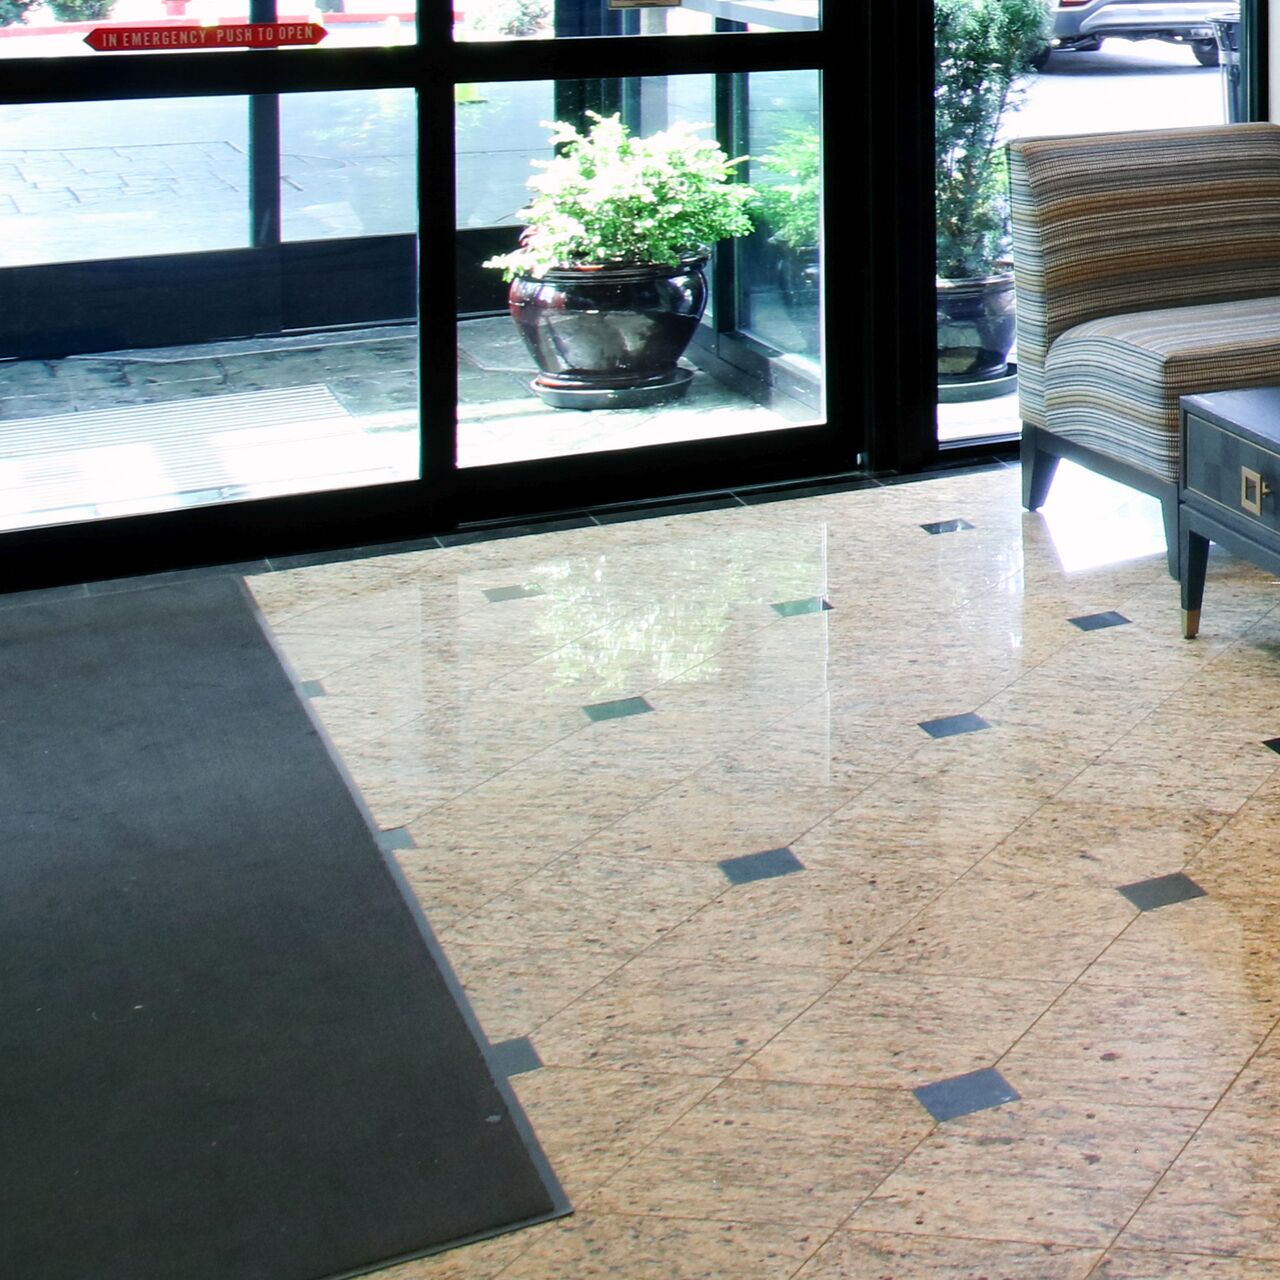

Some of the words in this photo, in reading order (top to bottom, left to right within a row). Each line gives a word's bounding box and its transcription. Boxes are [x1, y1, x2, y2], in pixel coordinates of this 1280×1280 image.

[102, 33, 117, 47] IN
[123, 30, 207, 47] EMERGENCY
[216, 28, 253, 43] PUSH
[258, 27, 274, 41] TO
[278, 26, 314, 40] OPEN
